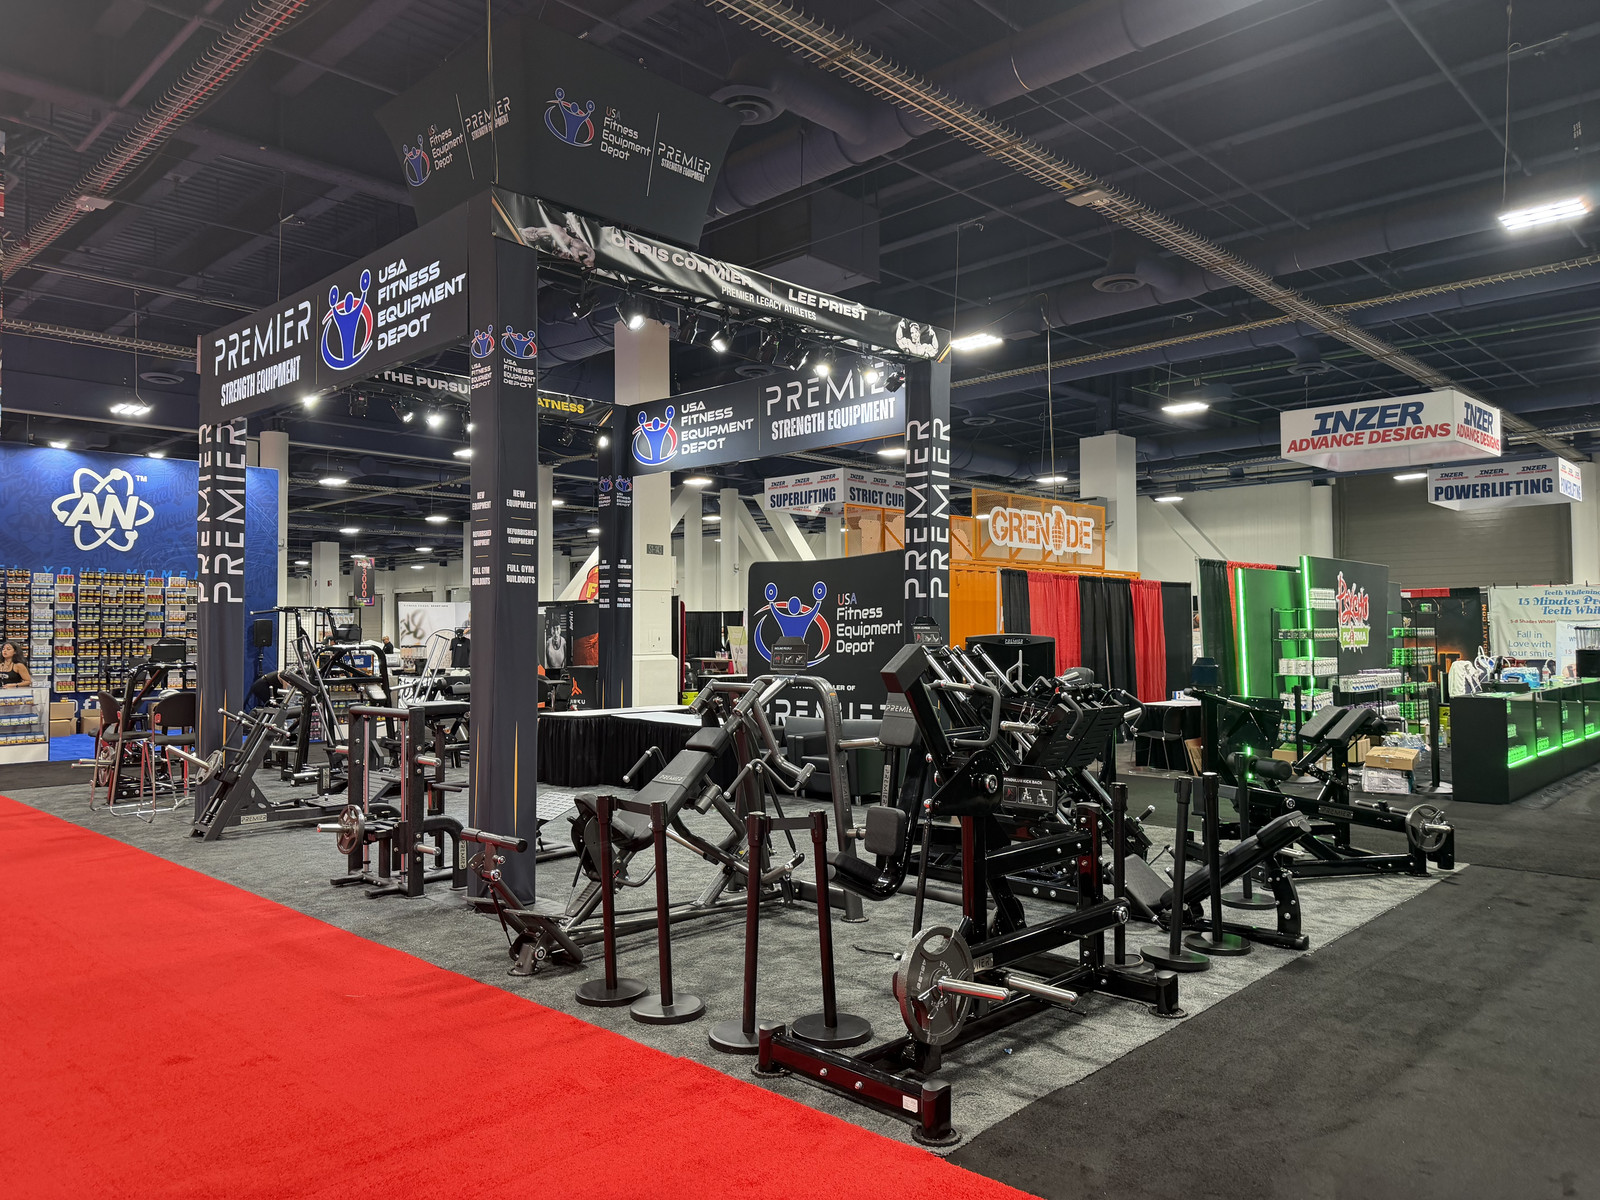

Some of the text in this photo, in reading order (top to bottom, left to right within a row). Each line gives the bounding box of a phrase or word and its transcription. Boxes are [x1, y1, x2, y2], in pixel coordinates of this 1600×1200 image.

[605, 106, 621, 120] USA
[603, 116, 639, 139] Fitness
[429, 128, 452, 147] Fitness
[431, 132, 464, 159] Equipment
[602, 129, 651, 157] Equipment
[600, 141, 630, 160] Depot
[657, 141, 711, 175] PREMIER
[434, 152, 453, 171] Depot
[378, 258, 408, 284] USA
[377, 260, 441, 305] FITNESS
[377, 272, 467, 328] EQUIPMENT
[721, 285, 817, 321] PREMIER LEGACY ATHLETES
[788, 288, 868, 321] LEE PRIEST
[214, 300, 312, 377] PREMIER
[377, 313, 431, 351] DEPOT
[503, 358, 518, 366] USA
[503, 363, 534, 375] FITNESS
[220, 355, 301, 407] STRENGTH EQUIPMENT
[383, 370, 414, 385] THE
[471, 379, 491, 390] DEPOT
[503, 370, 536, 383] EQUIPMENT
[503, 378, 533, 388] DEPOT
[765, 361, 885, 416] PREMIE
[681, 400, 706, 414] USA
[681, 406, 734, 427] FITNESS
[771, 396, 896, 441] STRENGTH EQUIPMENT
[1310, 400, 1425, 437] INZER
[1463, 401, 1494, 435] INZER
[681, 418, 754, 442] EQUIPMENT
[1286, 422, 1451, 454] ADVANCE DESIGNS
[1455, 423, 1500, 452] ADVANCE DESIGNS
[681, 437, 727, 455] DEPOT
[1479, 468, 1504, 476] INZER
[1521, 464, 1548, 472] INZER
[512, 489, 526, 499] NEW
[770, 486, 836, 509] SUPERLIFTING
[849, 486, 904, 508] STRICT CUR
[1434, 477, 1553, 501] POWERLIFTING
[64, 492, 139, 530] AN
[213, 422, 247, 604] PREMIER
[506, 498, 537, 510] EQUIPMENT
[904, 420, 930, 599] PREMIER
[930, 418, 951, 599] PREMIER
[507, 536, 535, 545] EQUIPMENT
[506, 563, 535, 573] FULL GYM
[506, 574, 536, 584] BUILDOUTS
[837, 592, 857, 606] USA
[1518, 597, 1530, 606] 15
[1533, 597, 1580, 606] Minutes
[836, 606, 883, 621] Fitness
[1541, 606, 1572, 615] Teeth
[836, 620, 903, 639] Equipment
[1517, 630, 1543, 639] Fall in
[836, 638, 875, 655] Depot
[1508, 640, 1552, 648] Love with
[1507, 650, 1553, 658] your smile
